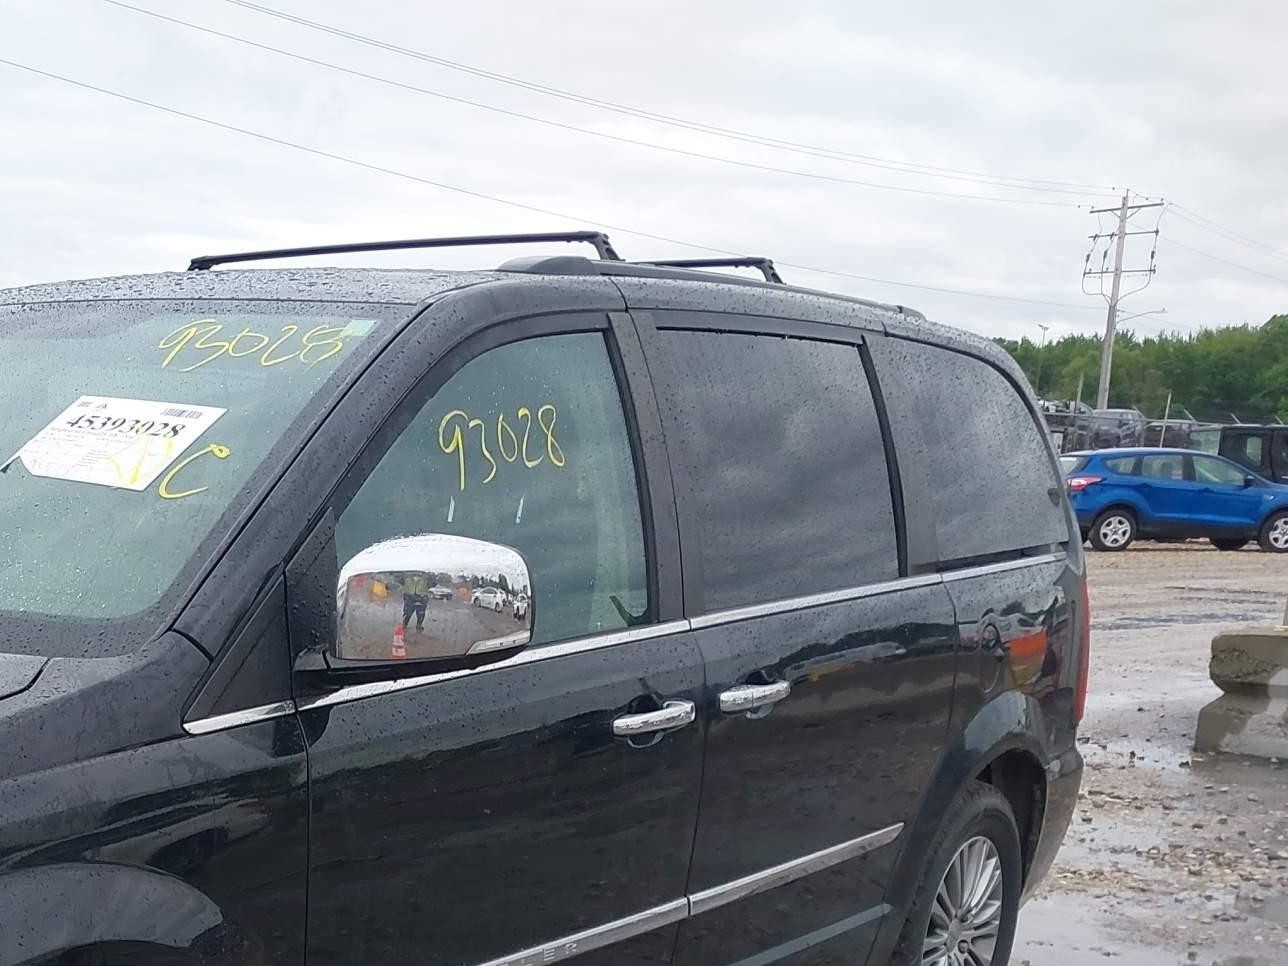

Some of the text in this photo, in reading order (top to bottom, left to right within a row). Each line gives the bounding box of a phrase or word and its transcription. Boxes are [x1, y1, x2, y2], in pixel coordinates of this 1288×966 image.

[158, 318, 348, 373] 93028
[66, 414, 186, 439] 45393028
[438, 405, 566, 491] 93028
